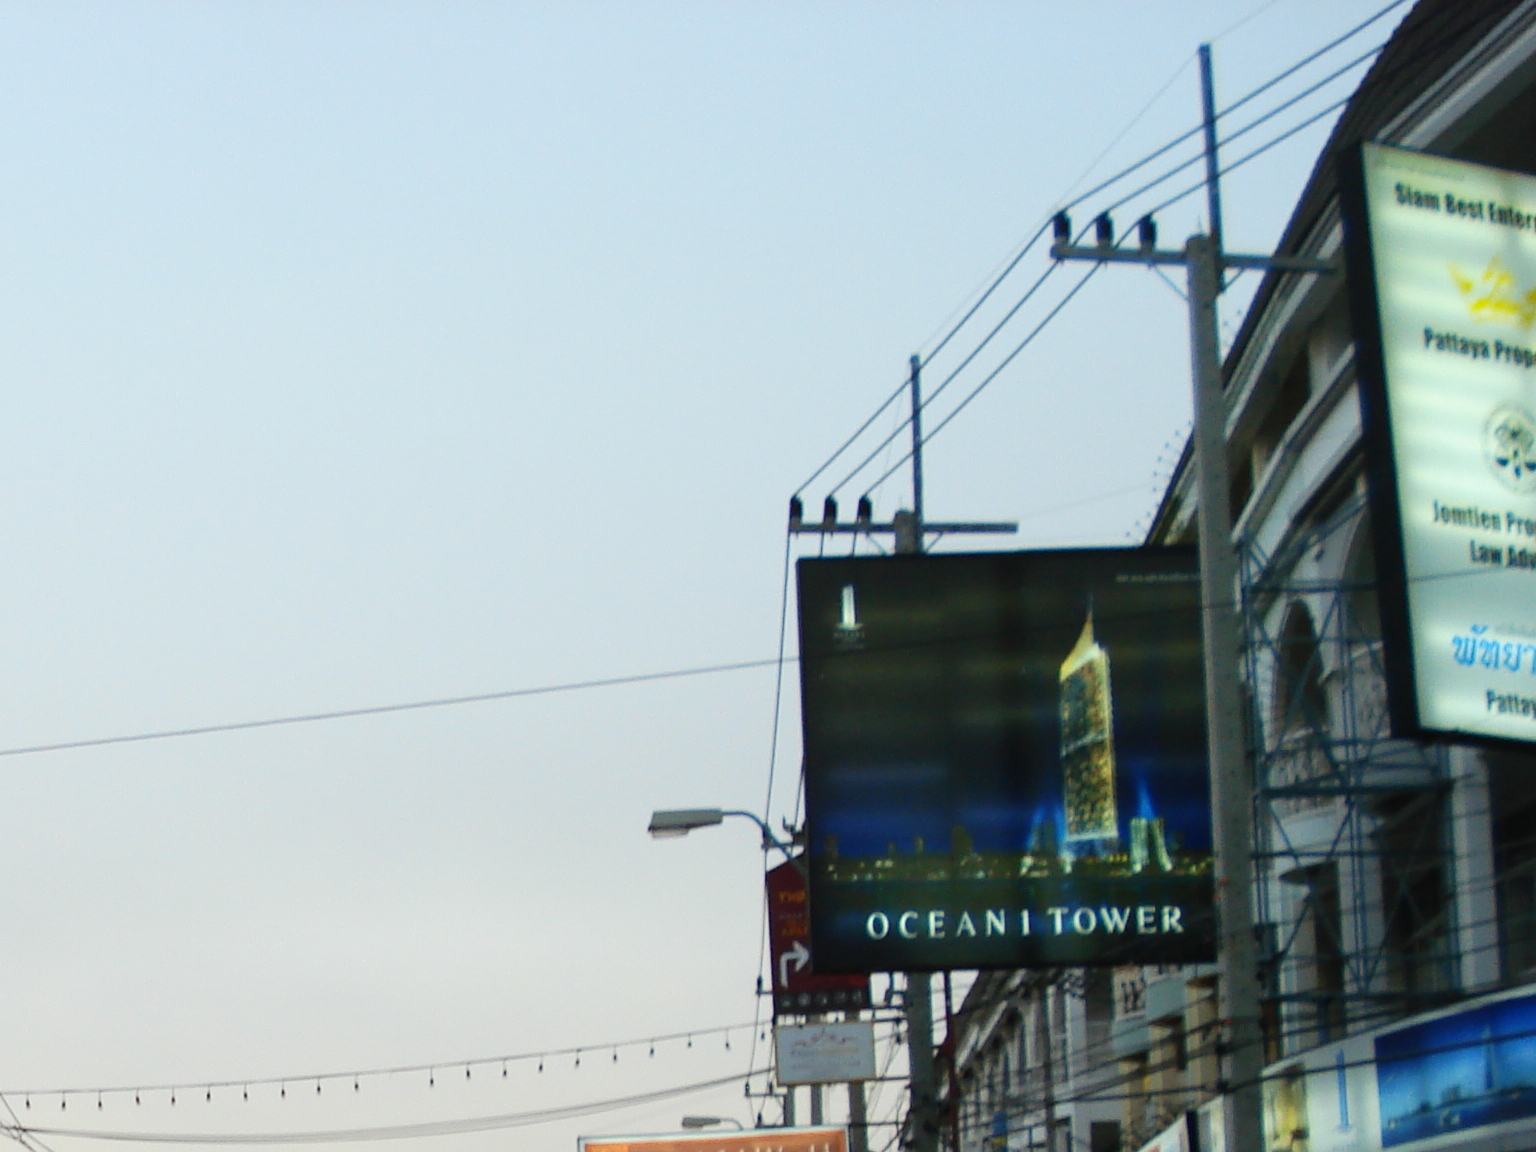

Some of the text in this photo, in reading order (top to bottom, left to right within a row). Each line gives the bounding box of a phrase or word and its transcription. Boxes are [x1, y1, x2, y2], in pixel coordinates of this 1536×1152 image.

[1395, 181, 1536, 232] Siam Best Enter
[1424, 325, 1536, 368] Pattaya Prop
[1434, 499, 1502, 531] Jomtien
[1470, 539, 1503, 565] Law
[866, 908, 1006, 940] OCEAN
[1047, 904, 1185, 936] TOWER
